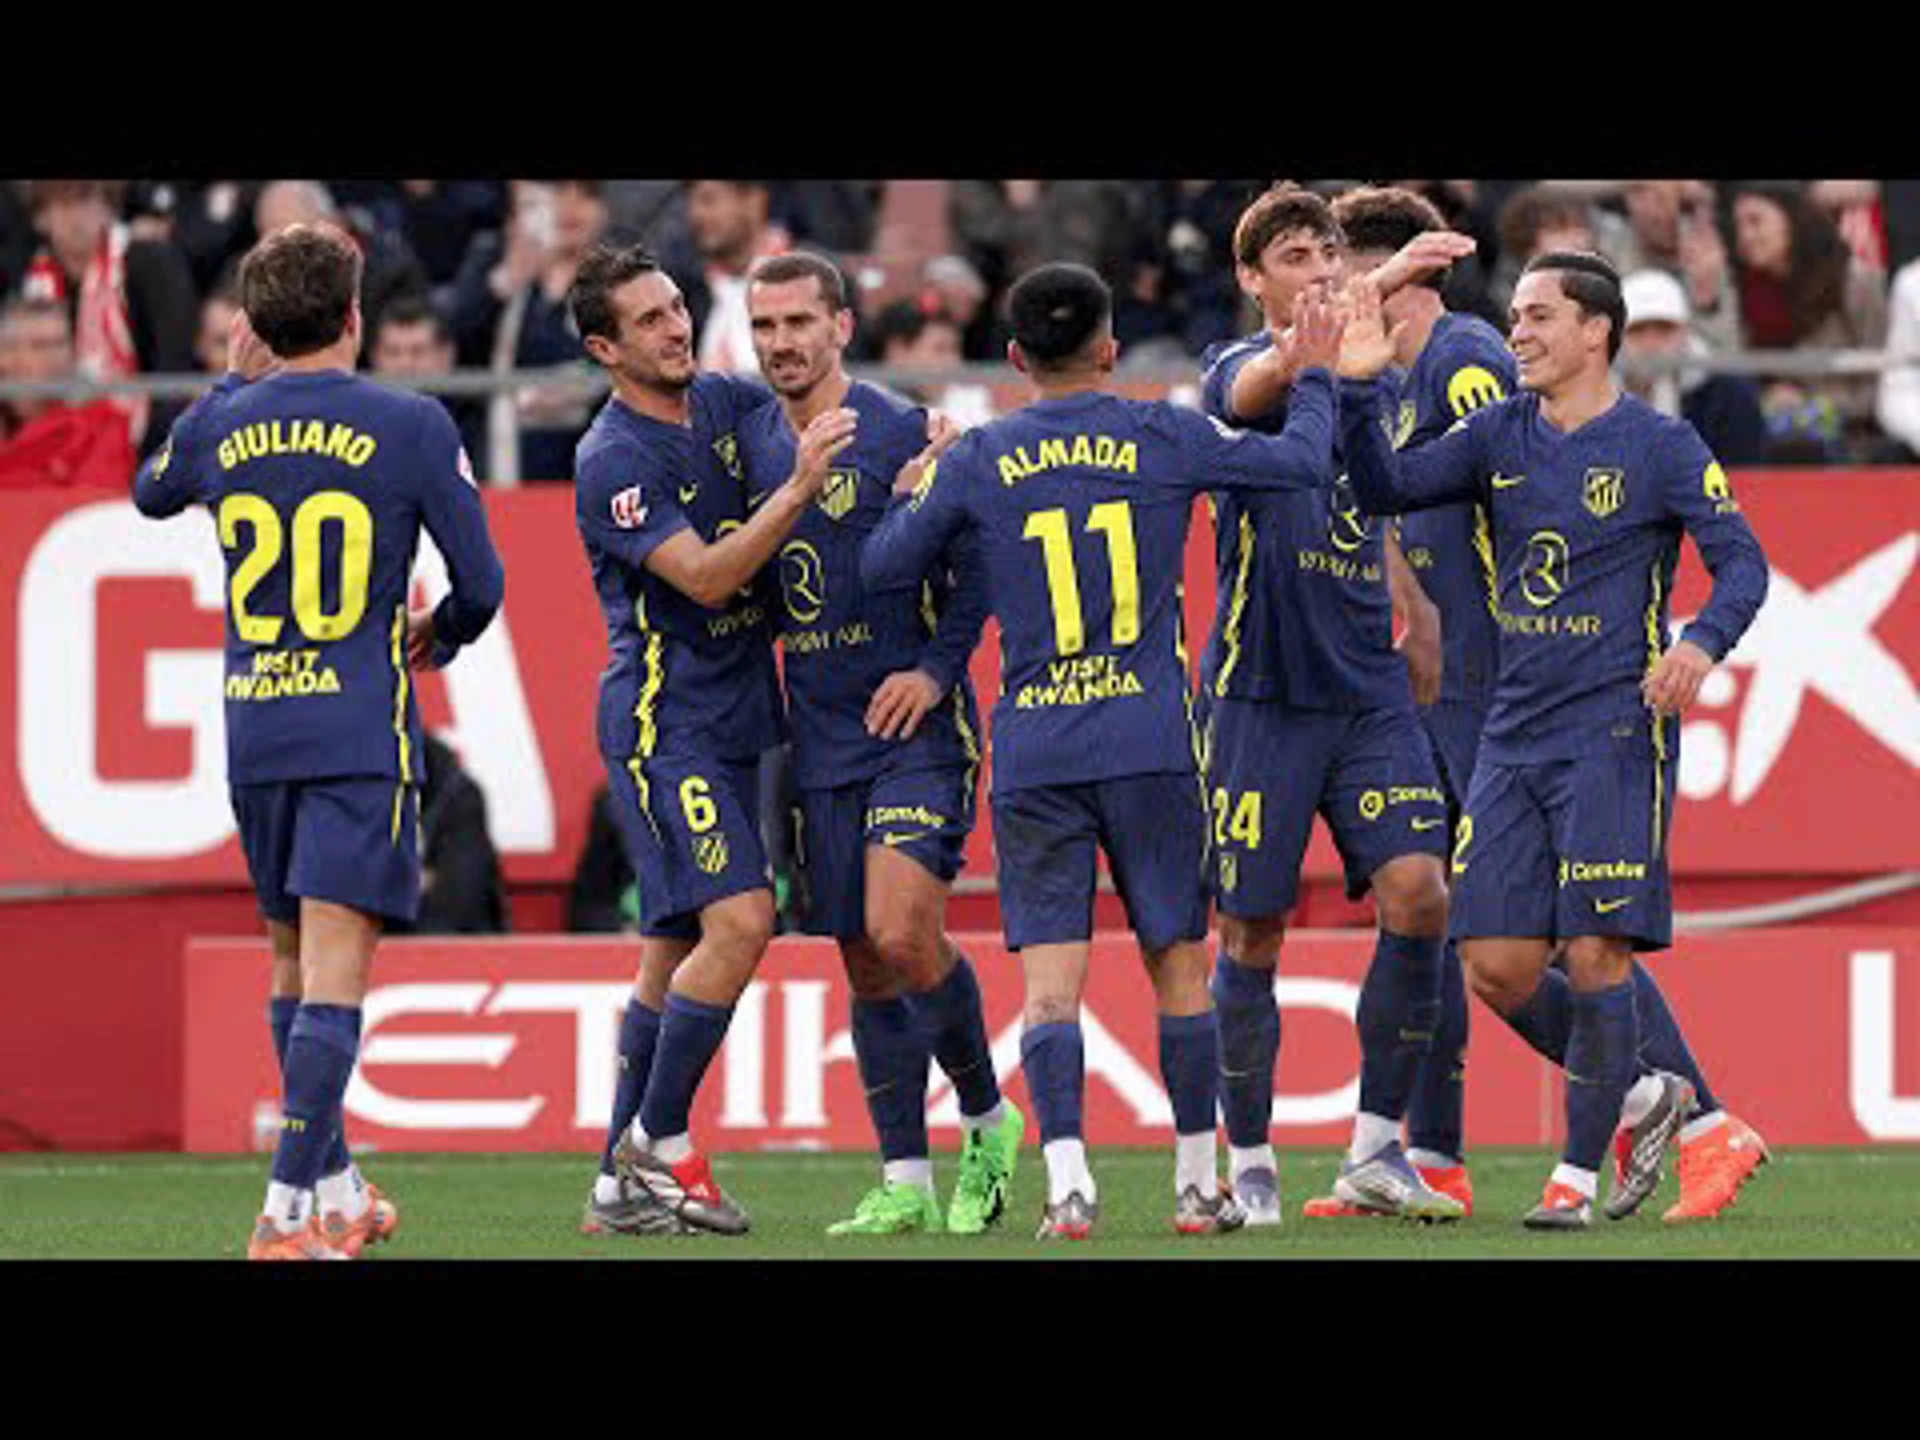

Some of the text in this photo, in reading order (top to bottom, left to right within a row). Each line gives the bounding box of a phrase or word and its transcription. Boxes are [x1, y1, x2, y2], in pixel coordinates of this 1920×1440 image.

[216, 420, 376, 470] GIULIANO
[997, 435, 1138, 486] ALMADA
[216, 490, 373, 643] 20
[1022, 500, 1140, 656] 11
[226, 667, 342, 700] RWANDA
[253, 650, 320, 675] VISIT
[1047, 655, 1120, 684] VISIT
[1015, 671, 1145, 710] RWANDA
[678, 774, 718, 832] 6
[1212, 786, 1262, 850] 24
